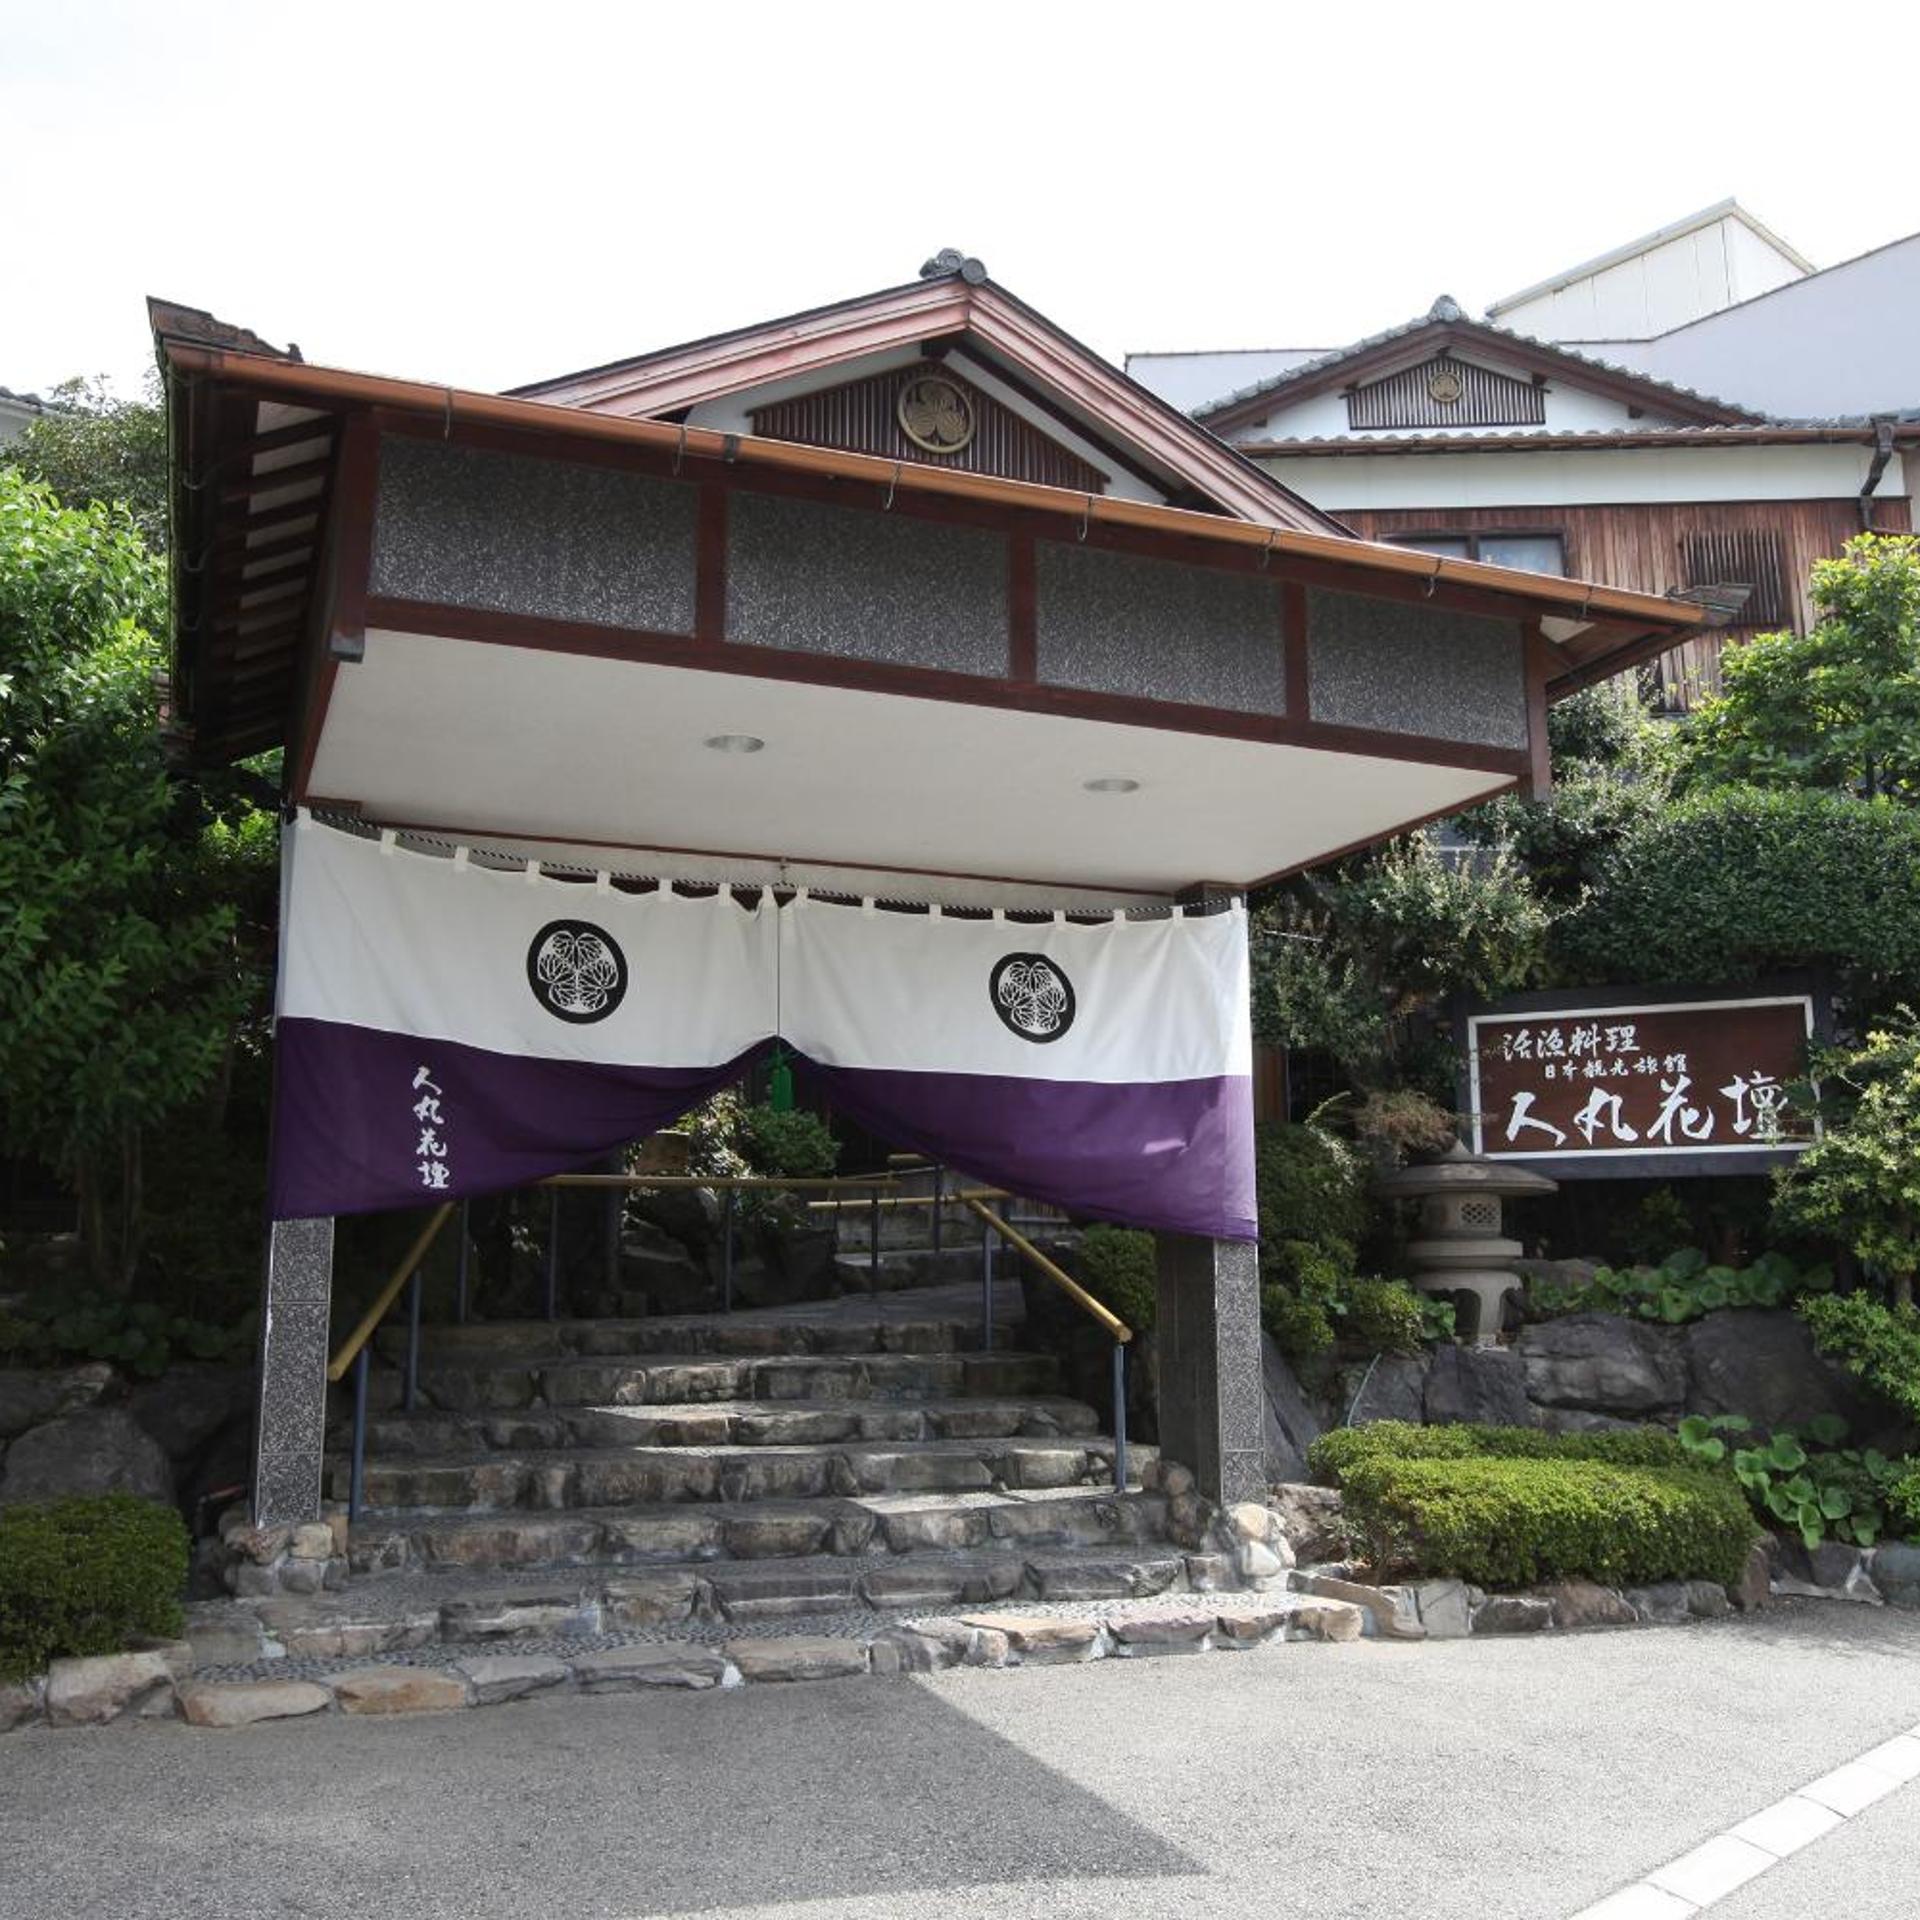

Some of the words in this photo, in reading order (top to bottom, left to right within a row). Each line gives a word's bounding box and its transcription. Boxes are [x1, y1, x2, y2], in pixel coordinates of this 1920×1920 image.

[412, 1065, 450, 1189] 人丸花壇
[1505, 1070, 1789, 1147] 人丸花壇
